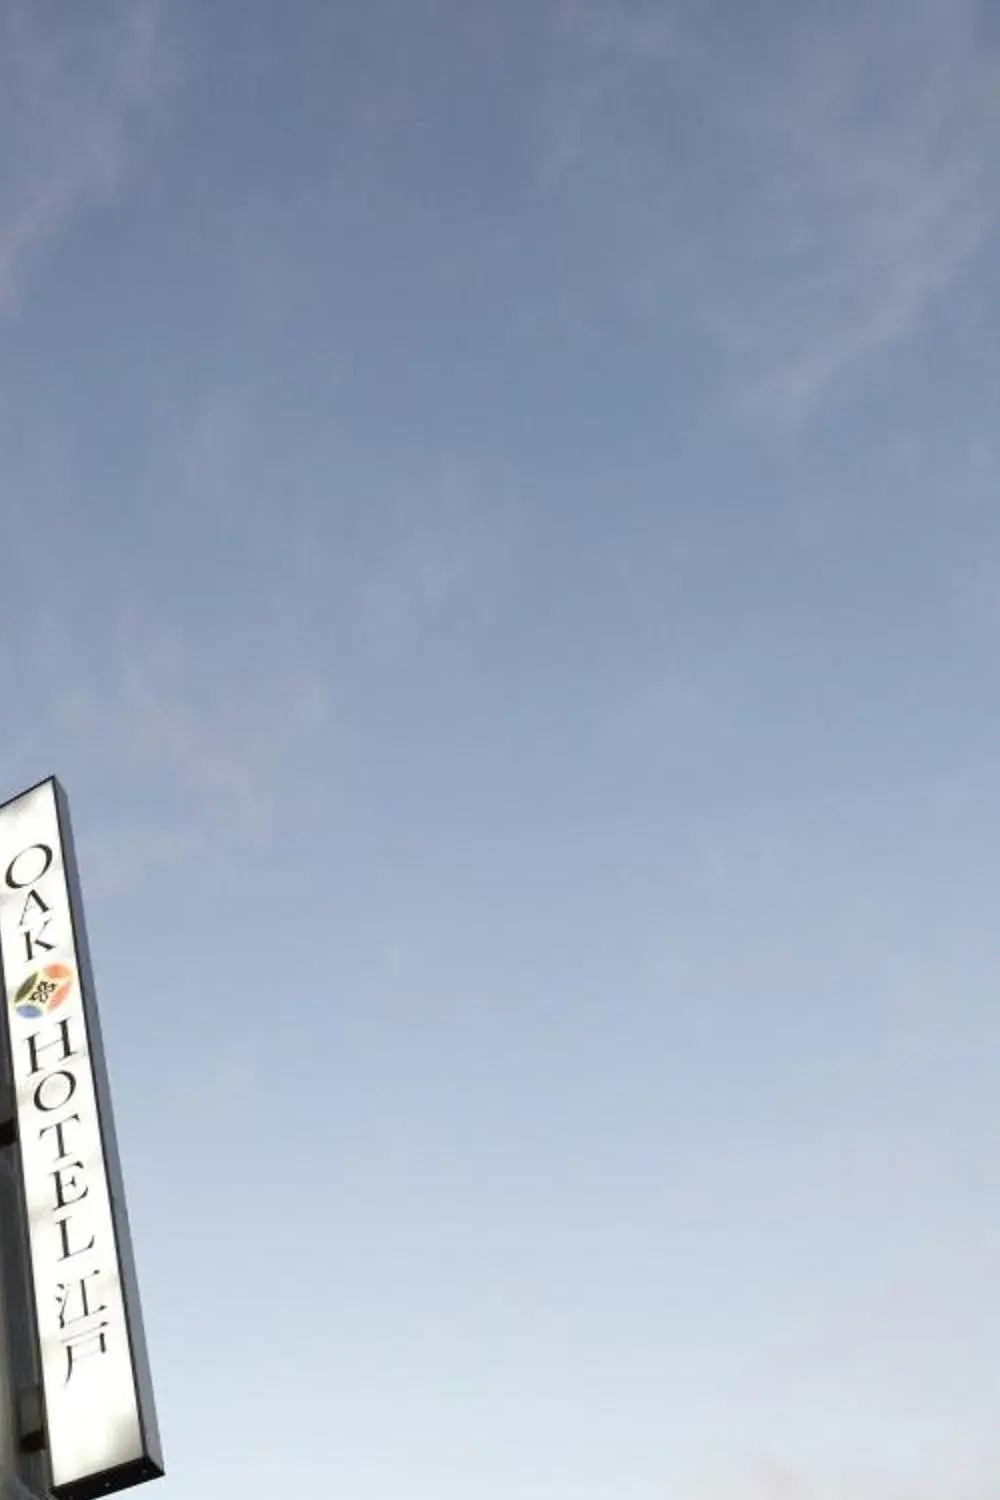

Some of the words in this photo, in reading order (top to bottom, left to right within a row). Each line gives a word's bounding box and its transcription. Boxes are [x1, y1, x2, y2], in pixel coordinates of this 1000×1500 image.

[5, 843, 57, 962] OAK
[24, 1015, 96, 1262] HOTEL
[55, 1268, 109, 1389] 江戸
